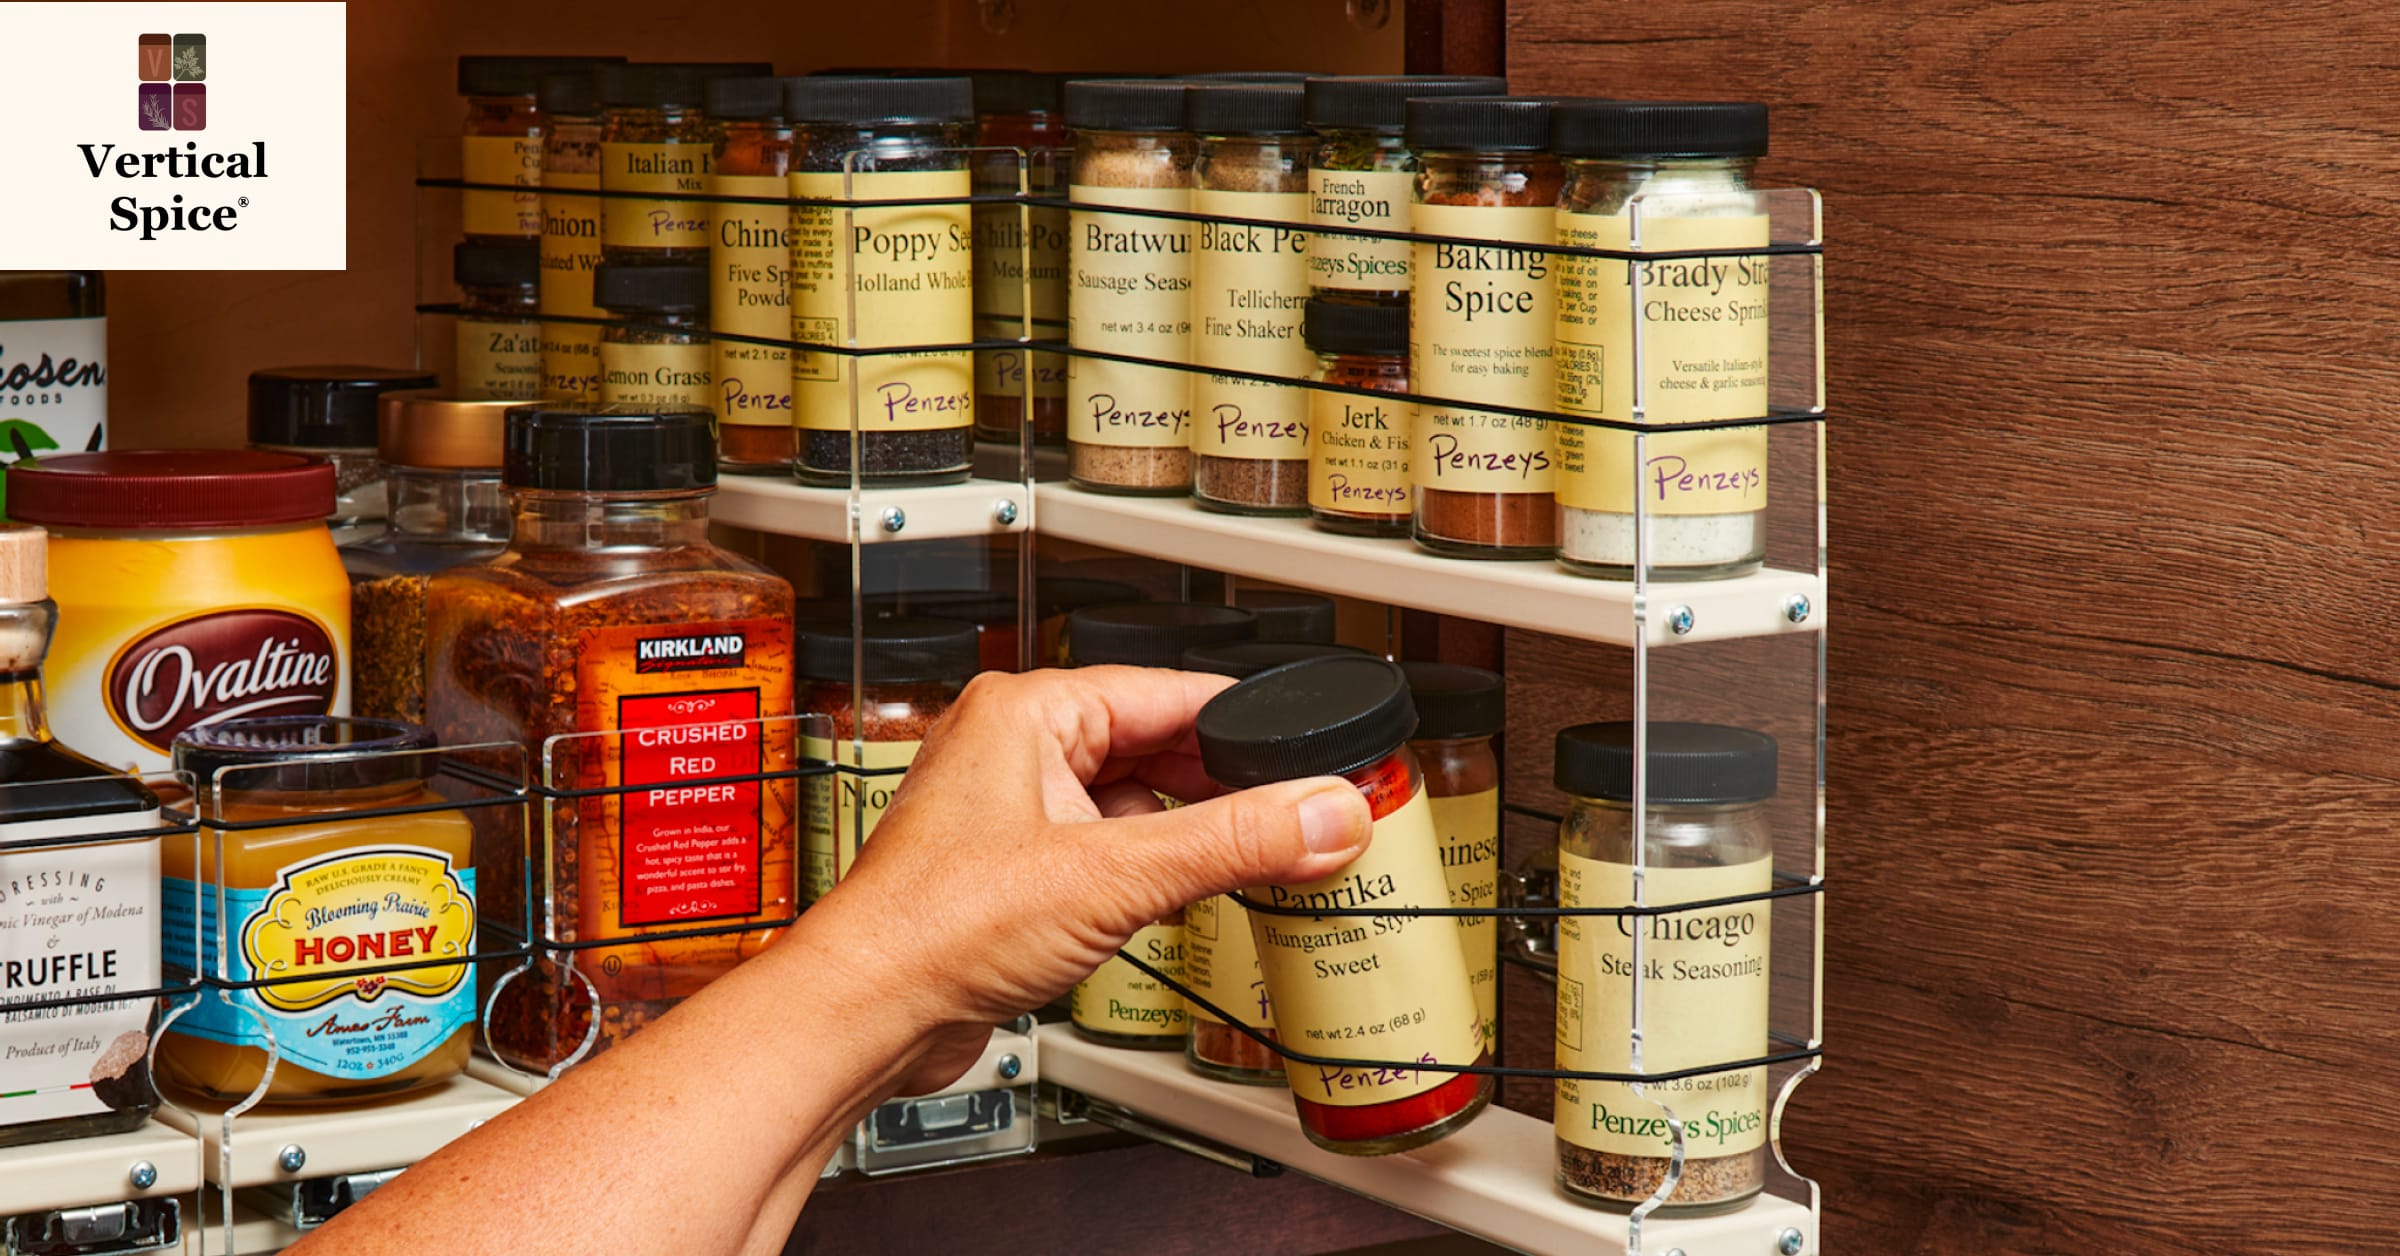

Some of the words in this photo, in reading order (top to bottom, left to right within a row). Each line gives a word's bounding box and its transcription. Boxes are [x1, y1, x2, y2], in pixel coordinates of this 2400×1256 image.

[627, 152, 693, 175] Italian
[677, 178, 703, 191] Mix
[1322, 178, 1365, 196] French
[648, 210, 710, 236] Penze
[854, 226, 941, 261] Poppy
[1200, 221, 1262, 253] Black
[728, 263, 763, 283] Five
[1347, 252, 1408, 281] Spices
[1435, 243, 1548, 280] Baking
[1077, 269, 1138, 295] Sausage
[1624, 256, 1728, 296] Brady
[1446, 280, 1534, 322] Spice
[1579, 301, 1598, 315] Cup
[1644, 300, 1722, 322] Cheese
[1101, 322, 1117, 333] net
[1120, 322, 1133, 333] wt
[1136, 322, 1154, 334] 3.4
[1158, 325, 1173, 334] oz
[1205, 316, 1232, 337] Fine
[1236, 318, 1294, 340] Shaker
[1432, 343, 1447, 357] The
[1450, 345, 1491, 358] sweetest
[1493, 346, 1522, 361] spice
[1524, 346, 1553, 358] blend
[655, 367, 712, 386] Grass
[1450, 361, 1464, 374] for
[1466, 365, 1489, 377] easy
[1493, 362, 1529, 378] baking
[1672, 359, 1721, 373] Versatile
[1659, 379, 1698, 390] cheese
[1700, 378, 1710, 390] &
[1712, 378, 1739, 392] garlic
[877, 382, 970, 421] Penzeys
[1341, 404, 1390, 430] Jerk
[1433, 414, 1449, 426] net
[1451, 416, 1465, 426] wt
[1469, 416, 1487, 428] 1.7
[1491, 419, 1507, 429] oz
[1511, 416, 1532, 431] (48
[1322, 431, 1366, 449] Chicken
[1369, 435, 1382, 450] &
[1351, 458, 1364, 469] 1.1
[1366, 460, 1379, 470] oz
[1381, 459, 1398, 472] (31
[1428, 433, 1550, 480] Penzeys
[1328, 473, 1406, 506] Penzeys
[1646, 455, 1760, 500] Penzeys
[639, 635, 744, 660] KIRKLAND
[125, 635, 331, 732] Ovaltine
[638, 723, 747, 747] CRUSHED
[670, 757, 716, 775] RED
[649, 785, 736, 807] PEPPER
[652, 828, 682, 838] Grown
[684, 827, 692, 835] in
[715, 825, 730, 833] our
[636, 842, 671, 853] Crushed
[673, 840, 690, 850] Red
[691, 838, 719, 849] Pepper
[662, 856, 683, 866] spicy
[684, 854, 704, 862] taste
[706, 852, 722, 861] that
[305, 872, 329, 888] RAW
[351, 862, 386, 874] GRADE
[390, 862, 398, 871] A
[399, 863, 430, 877] FANCY
[315, 874, 382, 896] DELICIOUSLY
[383, 873, 423, 886] CREAMY
[636, 869, 678, 880] wonderful
[679, 867, 706, 877] accent
[707, 867, 717, 875] to
[670, 881, 686, 891] and
[686, 880, 709, 891] pasta
[710, 878, 736, 888] dishes.
[40, 893, 64, 905] with
[1270, 872, 1397, 922] Paprika
[1460, 880, 1494, 905] Spice
[22, 912, 74, 930] Vinegar
[76, 906, 92, 927] of
[92, 903, 144, 920] Modena
[305, 897, 378, 931] Blooming
[382, 891, 431, 919] Prairie
[46, 934, 61, 950] &
[1264, 925, 1368, 954] Hungarian
[1616, 912, 1755, 947] Chicago
[294, 925, 439, 967] HONEY
[0, 949, 117, 989] RUFFLE
[1314, 953, 1380, 980] Sweet
[1601, 953, 1664, 980] Steak
[1672, 954, 1763, 981] Seasoning
[306, 1012, 370, 1038] Ames
[371, 1004, 431, 1032] Farm
[1108, 999, 1184, 1029] Penzeys
[1306, 1028, 1325, 1041] net
[1327, 1027, 1343, 1041] wt
[1345, 1025, 1366, 1039] 2.4
[1369, 1023, 1386, 1035] oz
[1389, 1014, 1411, 1033] (68
[1412, 1007, 1427, 1023] g)
[5, 1040, 54, 1060] Product
[58, 1039, 74, 1058] of
[73, 1035, 101, 1051] Italy
[332, 1036, 373, 1047] Watertown,
[373, 1034, 386, 1043] MN
[1672, 1077, 1693, 1092] 3.6
[1697, 1079, 1712, 1091] oz
[1715, 1074, 1740, 1092] (102
[1591, 1102, 1700, 1146] Penzeys
[1705, 1109, 1761, 1145] Spices
